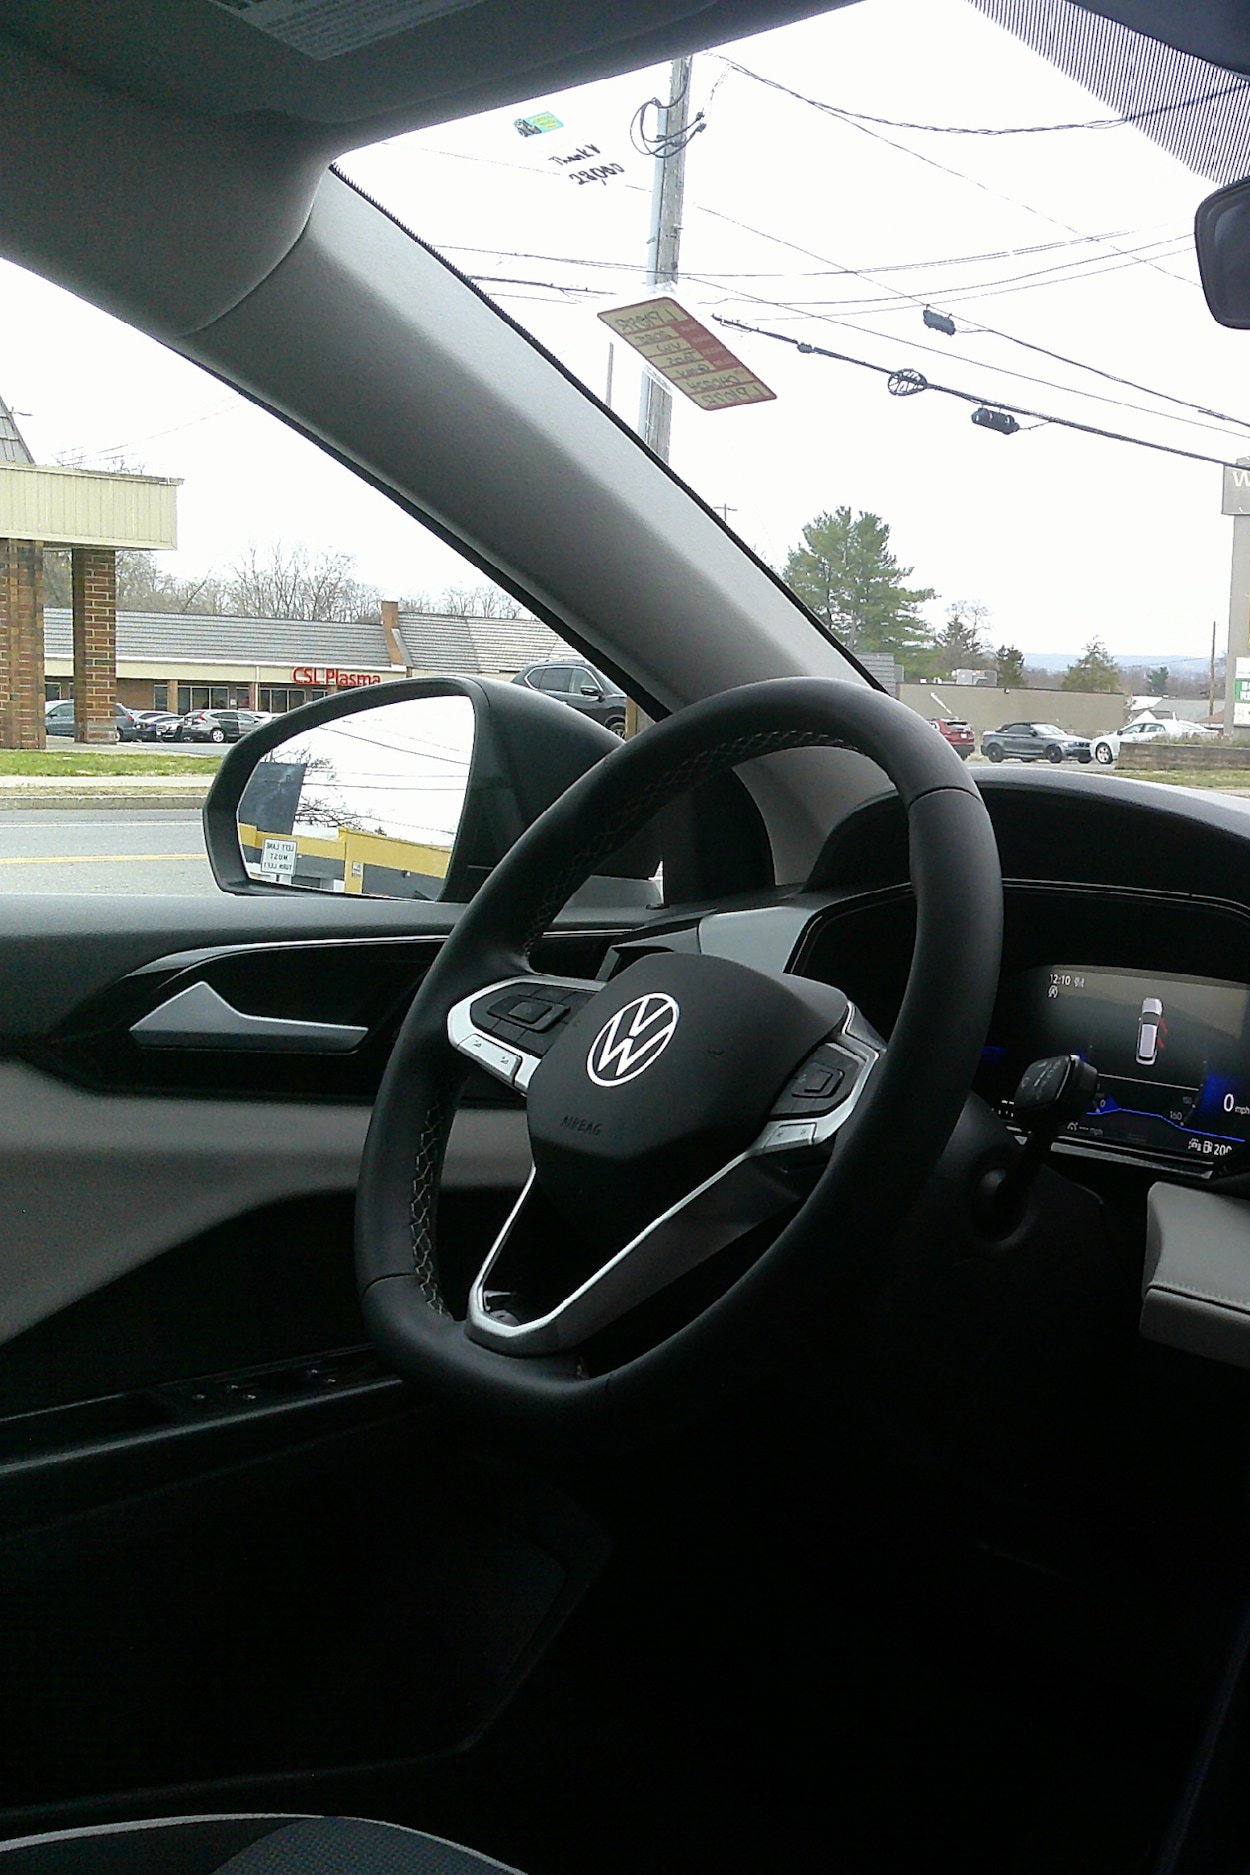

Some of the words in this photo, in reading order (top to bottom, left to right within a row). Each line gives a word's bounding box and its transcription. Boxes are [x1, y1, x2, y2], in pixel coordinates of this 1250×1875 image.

[292, 667, 320, 685] CSL
[325, 668, 382, 687] Plasma
[1050, 973, 1071, 986] 12:10
[1223, 1093, 1235, 1112] 0
